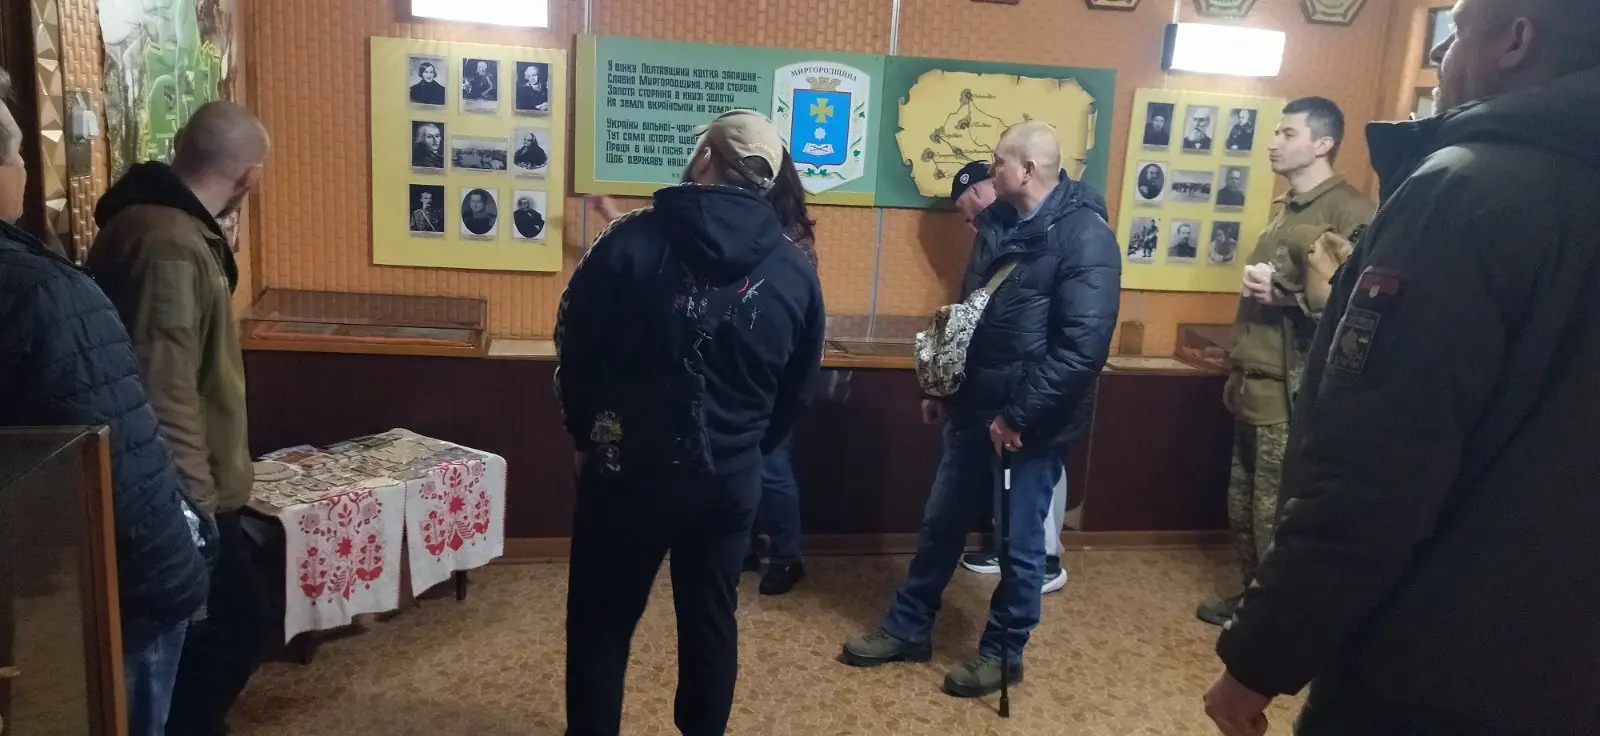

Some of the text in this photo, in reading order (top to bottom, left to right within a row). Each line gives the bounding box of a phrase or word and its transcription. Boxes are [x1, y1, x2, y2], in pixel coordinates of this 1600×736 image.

[607, 60, 613, 71] У
[641, 63, 690, 77] Полтавщини
[791, 66, 857, 81] МИРГОРОДЩИНА
[607, 73, 636, 85] Славна
[607, 84, 635, 96] Золота
[606, 97, 617, 107] На
[606, 117, 639, 130] України
[606, 130, 620, 141] Тут
[606, 141, 630, 153] Праця
[605, 152, 624, 164] Щоб
